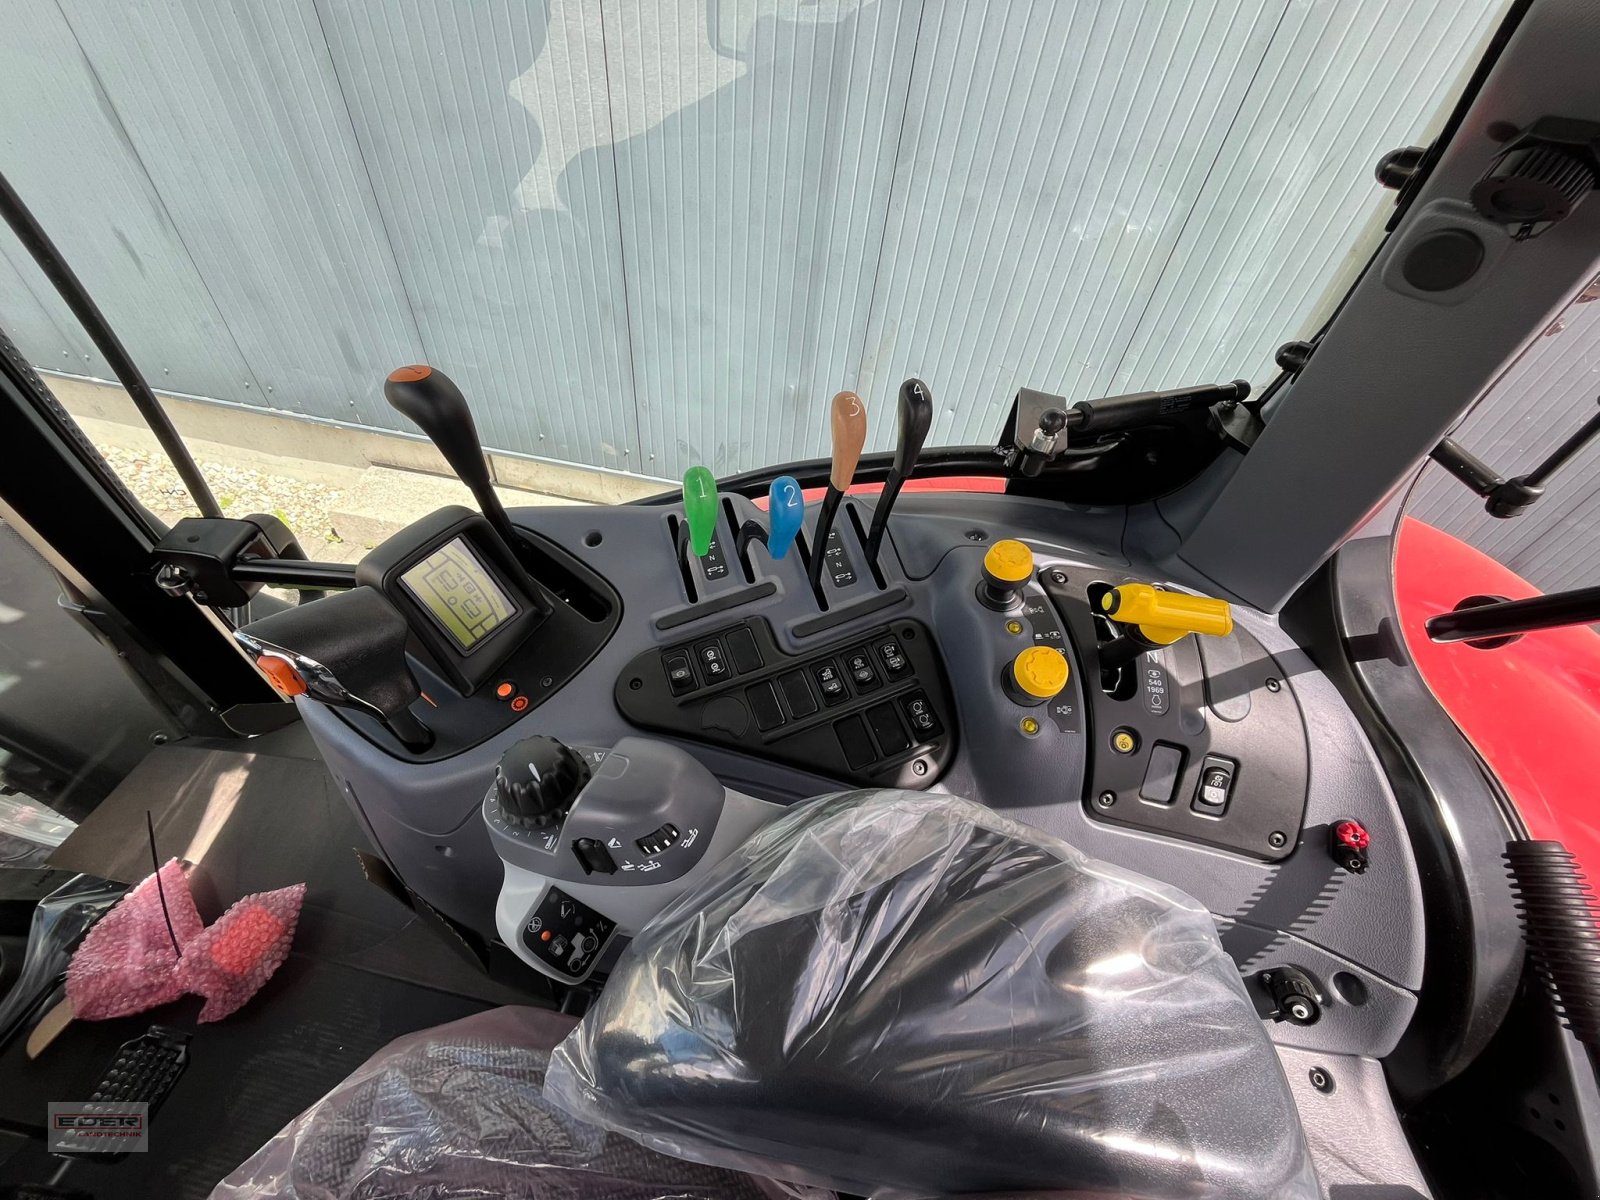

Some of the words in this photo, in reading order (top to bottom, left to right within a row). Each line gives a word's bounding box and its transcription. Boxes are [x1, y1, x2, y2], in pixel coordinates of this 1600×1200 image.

[913, 383, 924, 400] 4
[845, 396, 860, 416] 3
[695, 475, 707, 498] 1
[783, 485, 798, 507] 2
[1146, 651, 1159, 664] N
[1147, 686, 1164, 694] 1969
[1148, 679, 1162, 687] 540
